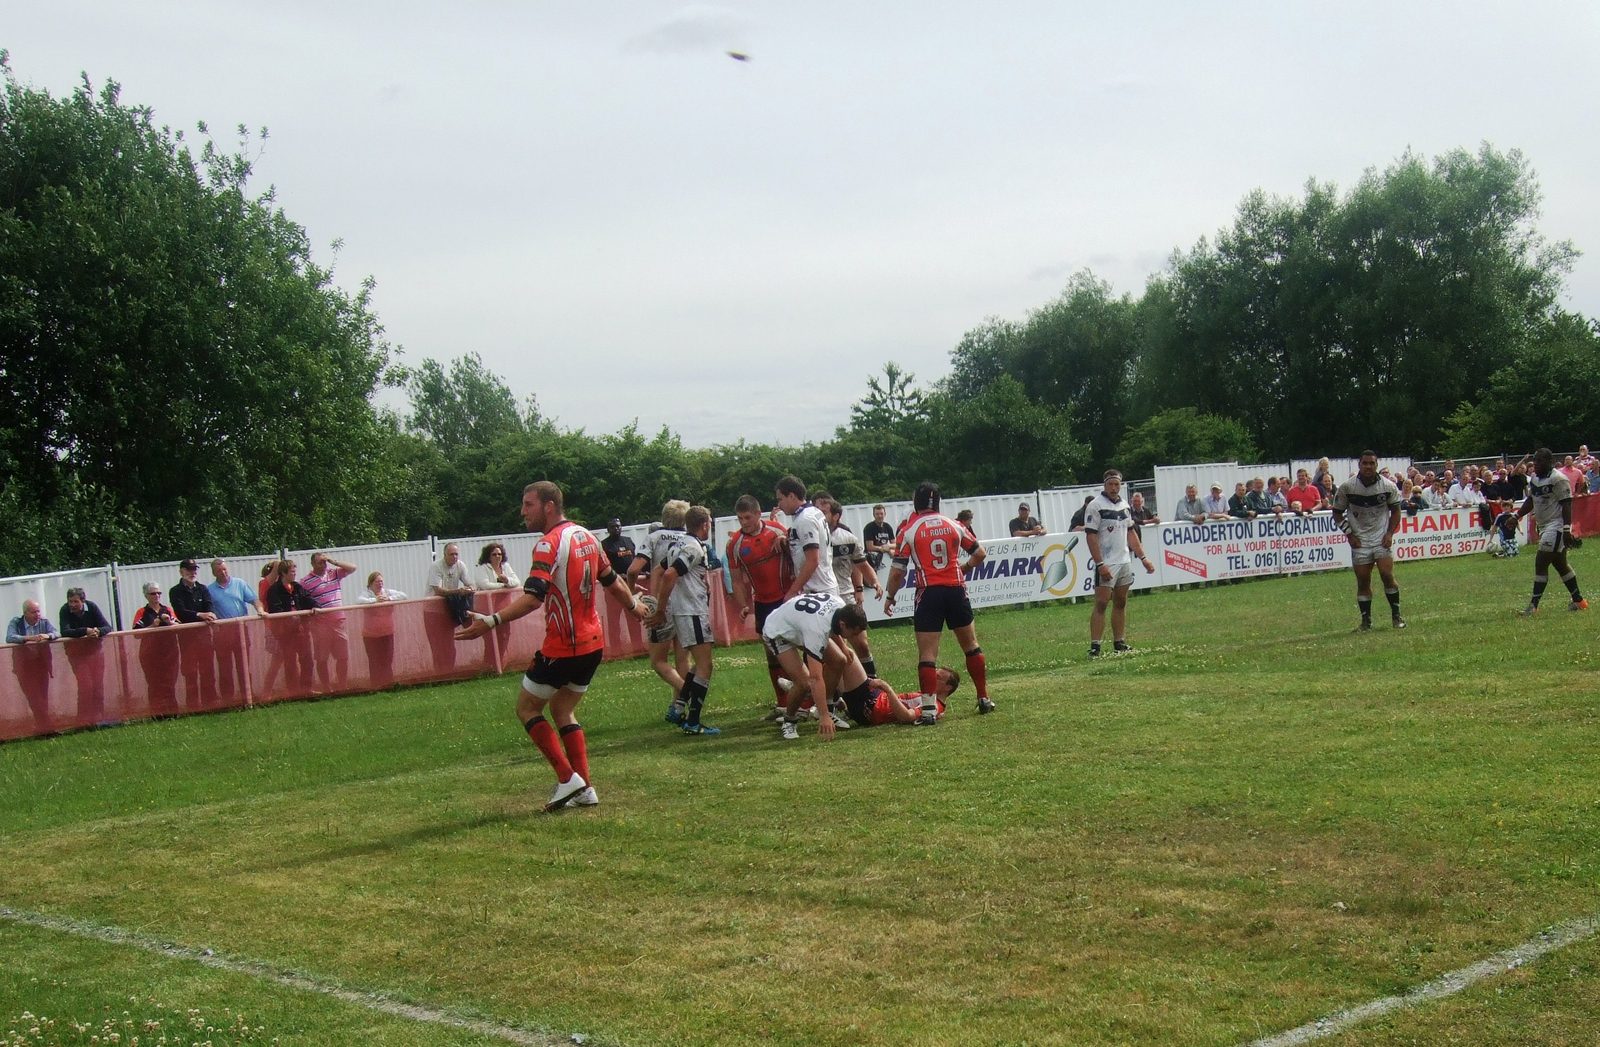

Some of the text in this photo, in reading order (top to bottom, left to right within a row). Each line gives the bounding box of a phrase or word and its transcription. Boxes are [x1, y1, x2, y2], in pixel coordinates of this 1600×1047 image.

[1163, 516, 1338, 545] CHADDERTON DECORATING
[1408, 533, 1441, 545] sponsorship
[1442, 532, 1453, 541] and
[1454, 529, 1483, 540] advertising
[997, 544, 1010, 555] US
[1012, 543, 1018, 553] A
[1226, 543, 1241, 554] ALL
[1244, 540, 1267, 552] YOUR
[1270, 536, 1323, 550] DECORATING
[1326, 534, 1350, 545] NEED
[1396, 539, 1486, 559] 0161 628 3677
[930, 539, 949, 570] 9
[1227, 547, 1334, 571] TEL: 0161 652 4709
[580, 560, 593, 600] 4
[994, 579, 1036, 591] LIMITED
